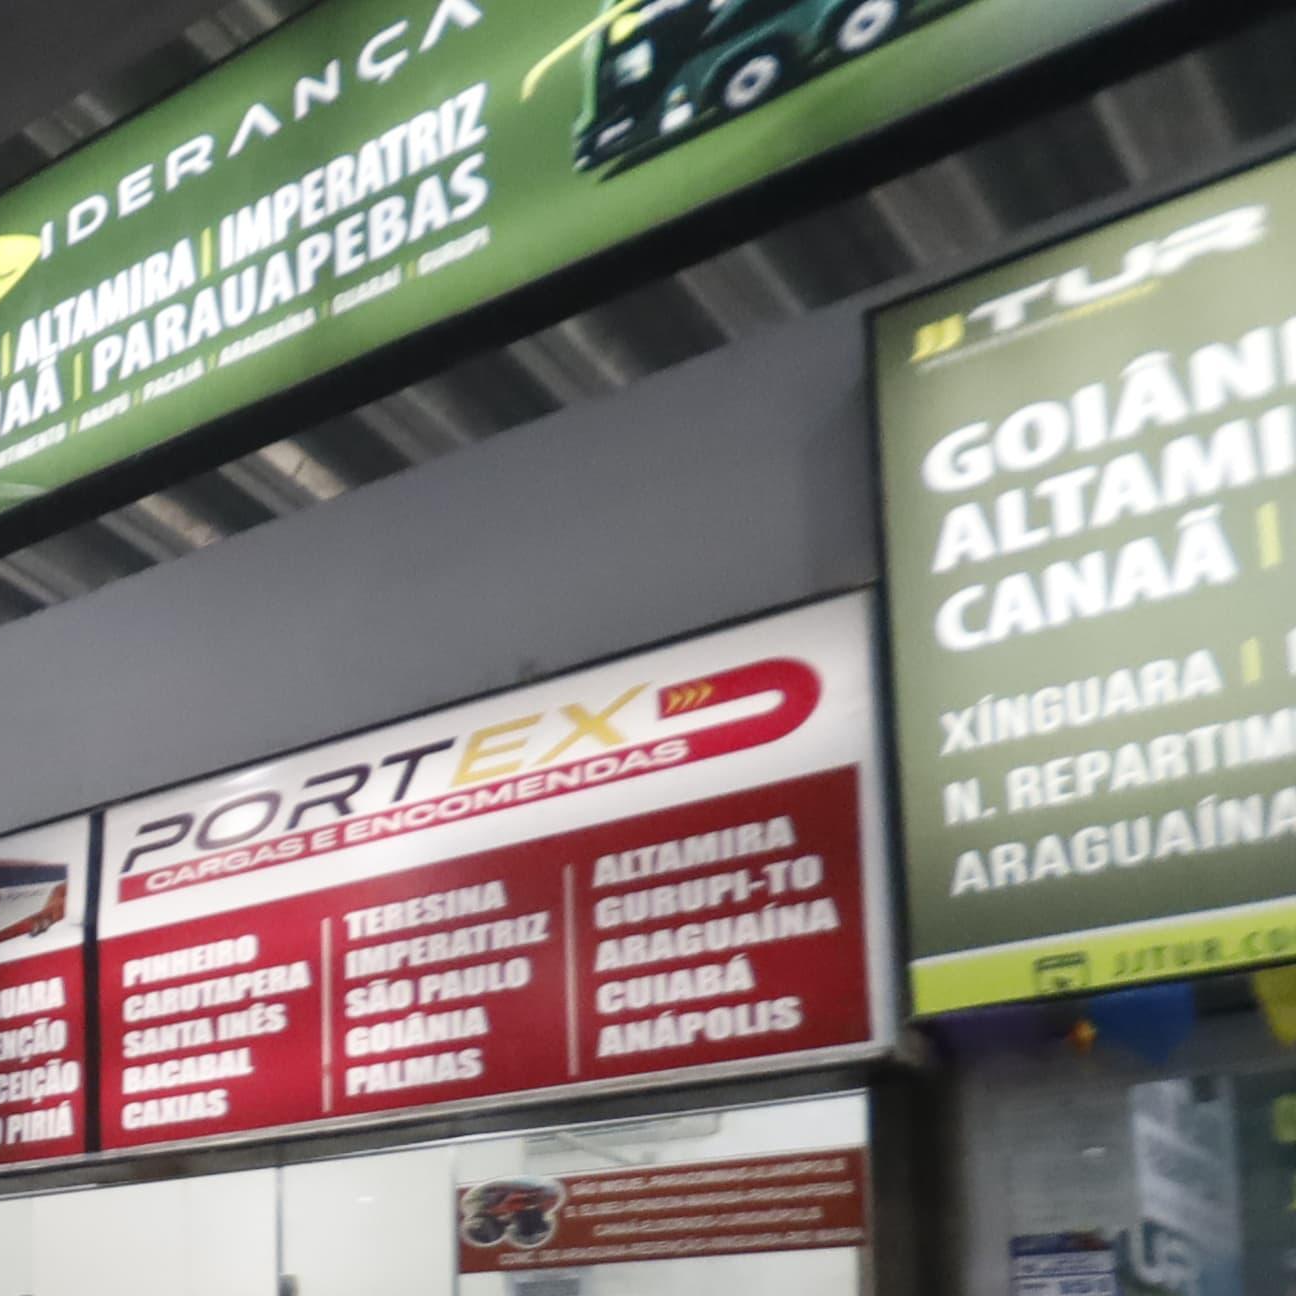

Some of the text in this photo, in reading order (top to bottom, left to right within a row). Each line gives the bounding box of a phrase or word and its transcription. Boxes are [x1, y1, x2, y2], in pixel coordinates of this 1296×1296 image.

[13, 238, 196, 373] ALTAMIRA
[219, 82, 488, 271] IMPERATRIZ
[92, 152, 490, 392] PARAUAPEBAS
[933, 503, 1240, 652] CANAÃ
[940, 648, 1223, 756] XÍNGUARA
[120, 681, 653, 873] PORTEX
[944, 777, 998, 826] N.
[145, 739, 690, 893] CARGAS E ENCOMENDAS
[592, 815, 797, 888] ALTAMIRA
[344, 880, 507, 940] TERESINA
[594, 854, 824, 930] GURUPI-TO
[122, 934, 259, 988] PINHEIRO
[345, 911, 550, 980] IMPERATRIZ
[594, 897, 841, 973] ARAGUAÍNA
[122, 961, 312, 1023] CARUTAPERA
[345, 957, 532, 1019] SÃO PAULO
[595, 953, 756, 1015] CUIABÁ
[123, 1003, 288, 1059] SANTA INÊS
[345, 1006, 489, 1058] GOIÂNIA
[595, 996, 803, 1058] ANÁPOLIS
[122, 1047, 255, 1094] BACABAL
[345, 1049, 485, 1097] PALMAS
[6, 1100, 75, 1145] PIRIÁ
[122, 1089, 229, 1130] CAXIAS
